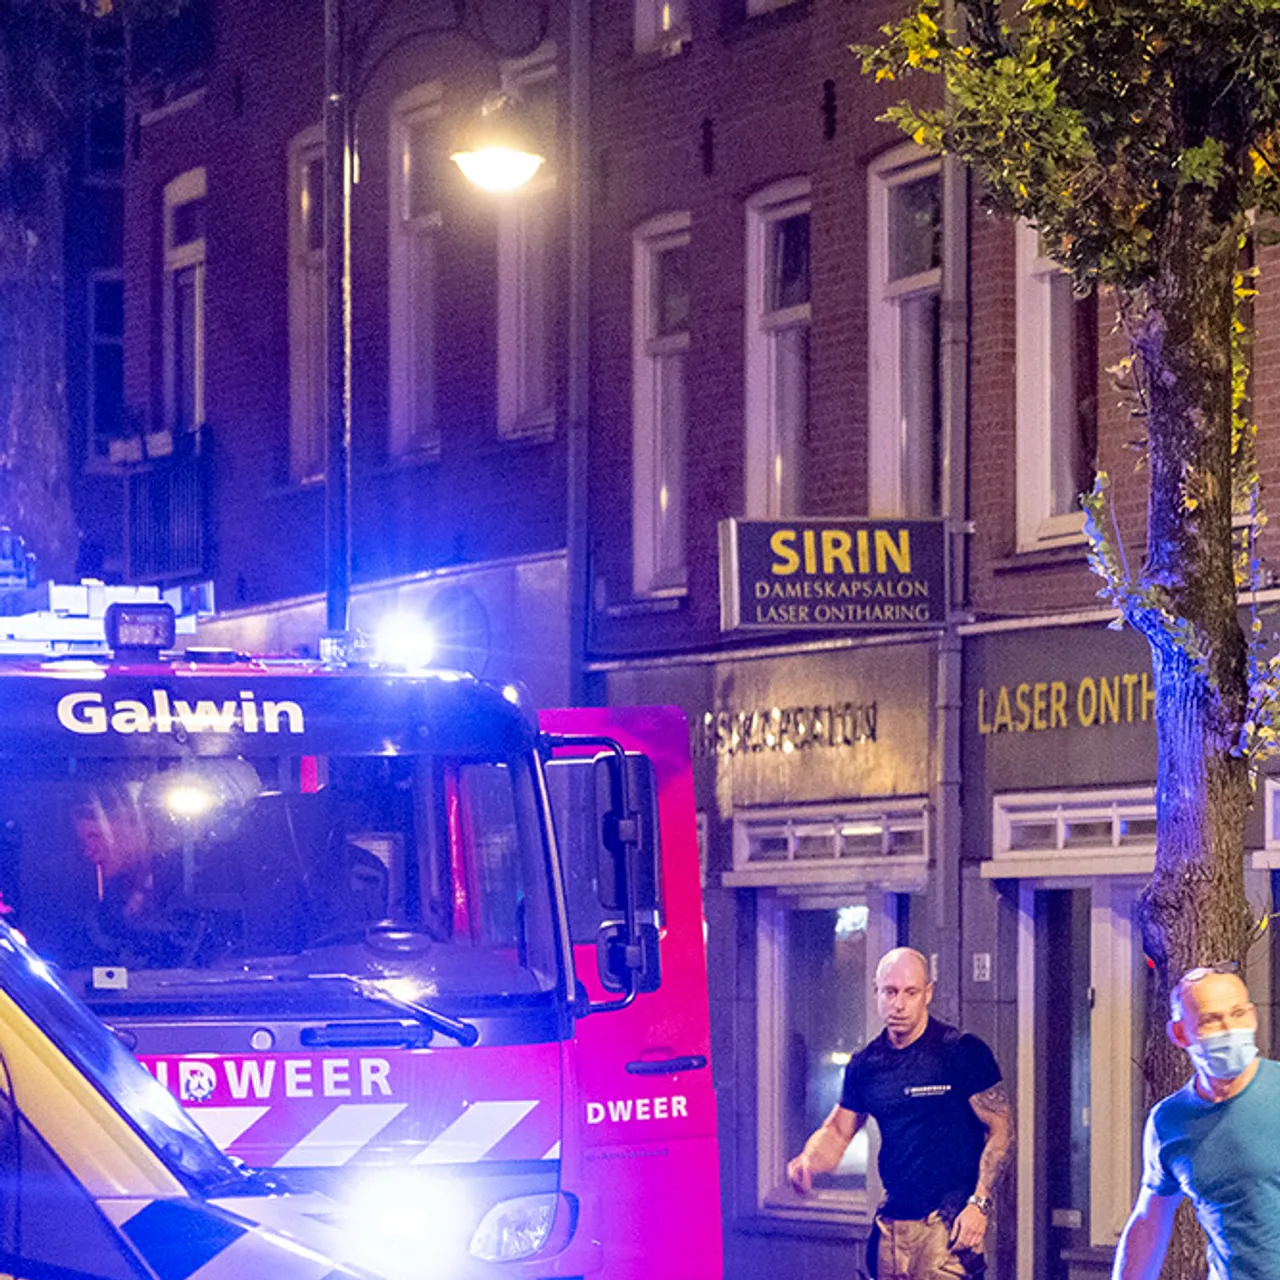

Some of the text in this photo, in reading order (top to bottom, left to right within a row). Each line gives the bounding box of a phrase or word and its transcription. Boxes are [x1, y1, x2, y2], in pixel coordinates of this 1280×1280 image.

[769, 529, 912, 575] SIRIN
[755, 580, 929, 599] DAMESKAPSALON
[756, 603, 930, 622] LASER ONTHARING
[56, 689, 305, 734] Galwin
[977, 680, 1068, 735] LASER
[586, 1095, 689, 1125] DWEER
